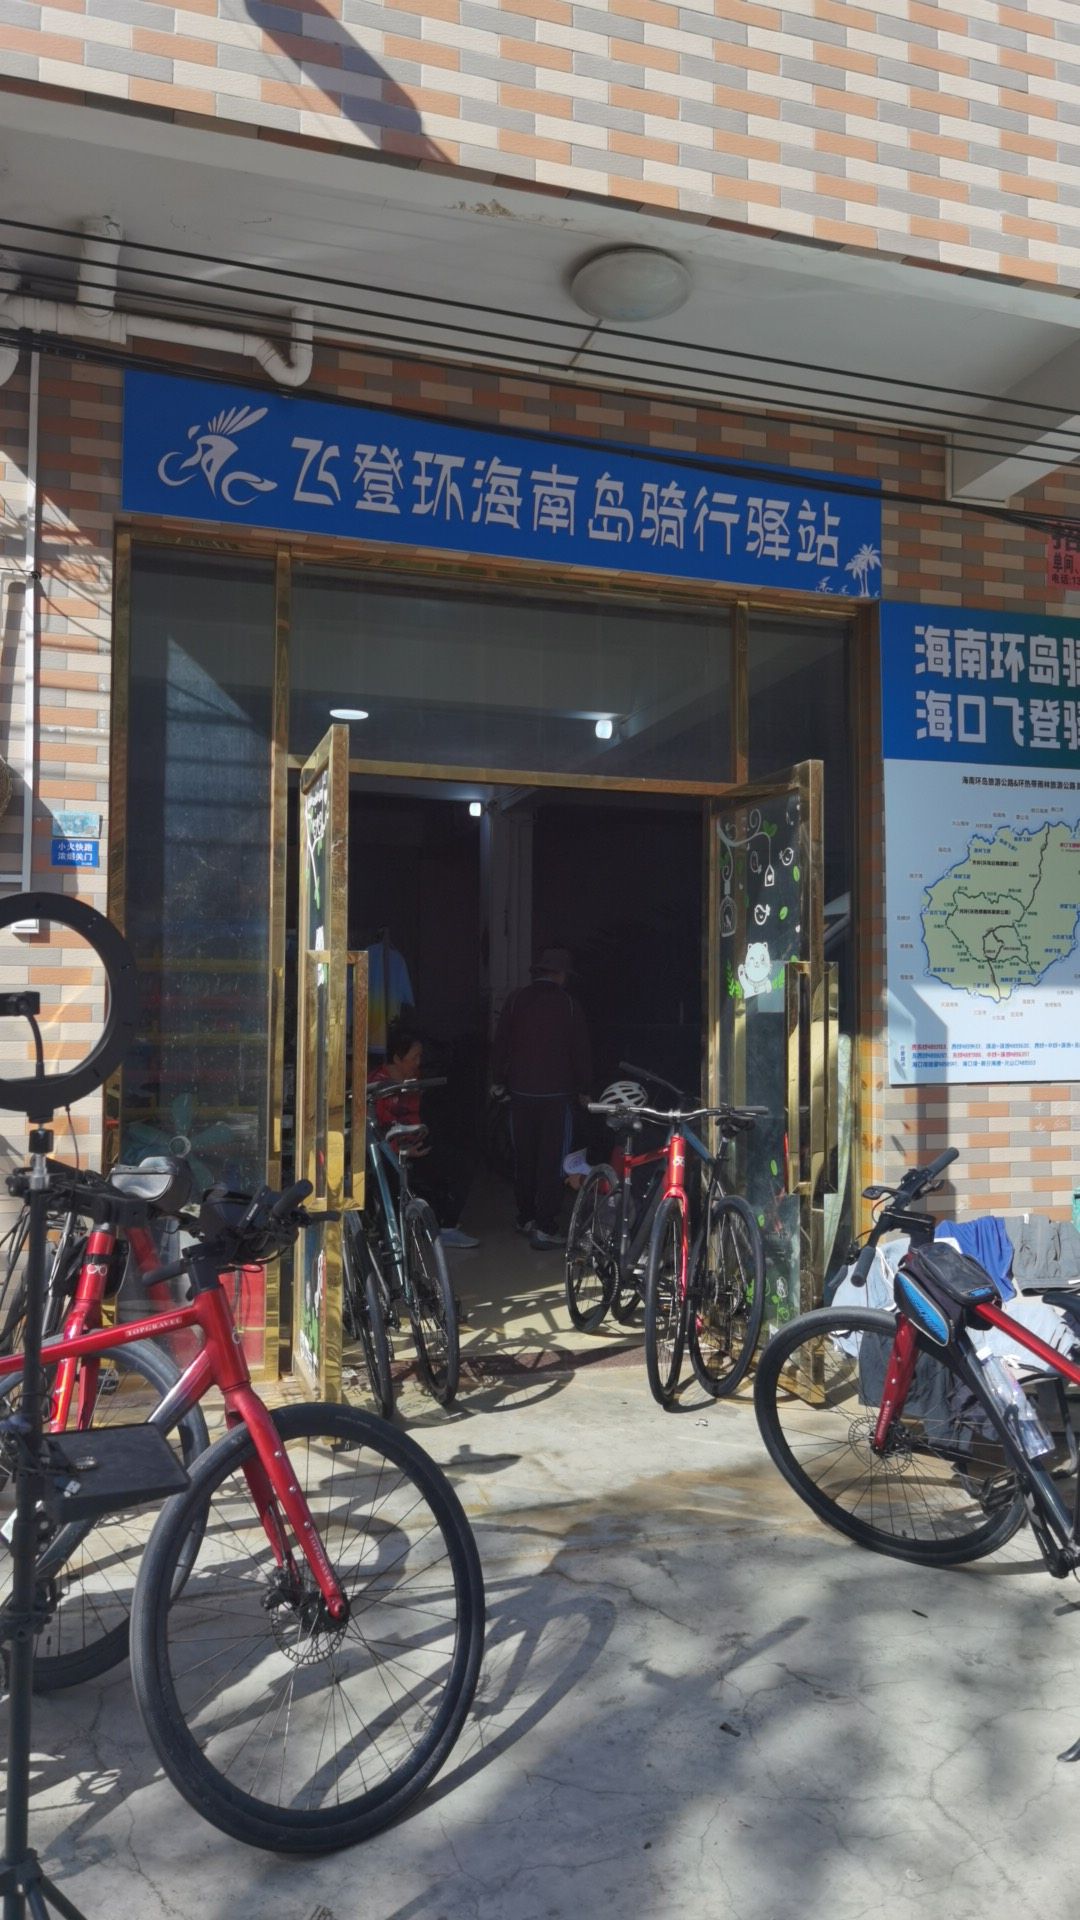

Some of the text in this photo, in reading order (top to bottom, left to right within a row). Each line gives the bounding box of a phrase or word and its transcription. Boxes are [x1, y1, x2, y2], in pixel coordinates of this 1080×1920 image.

[290, 436, 841, 566] 飞登环海南岛骑行驿站
